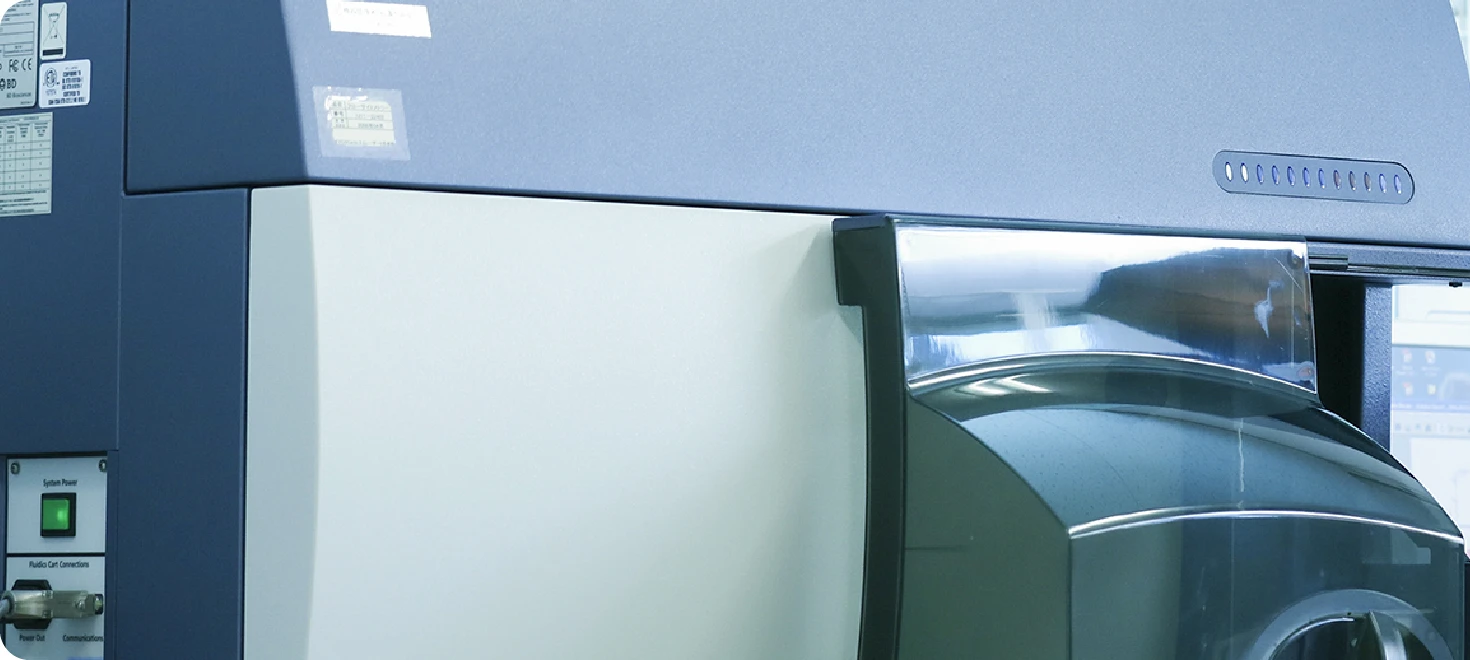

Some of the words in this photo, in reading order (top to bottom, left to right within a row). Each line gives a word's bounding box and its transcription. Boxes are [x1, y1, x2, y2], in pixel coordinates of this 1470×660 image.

[43, 478, 61, 488] System
[62, 478, 78, 487] Power
[60, 560, 89, 568] Connections
[19, 634, 35, 642] Power
[36, 634, 45, 642] Out
[62, 634, 103, 642] Communications
